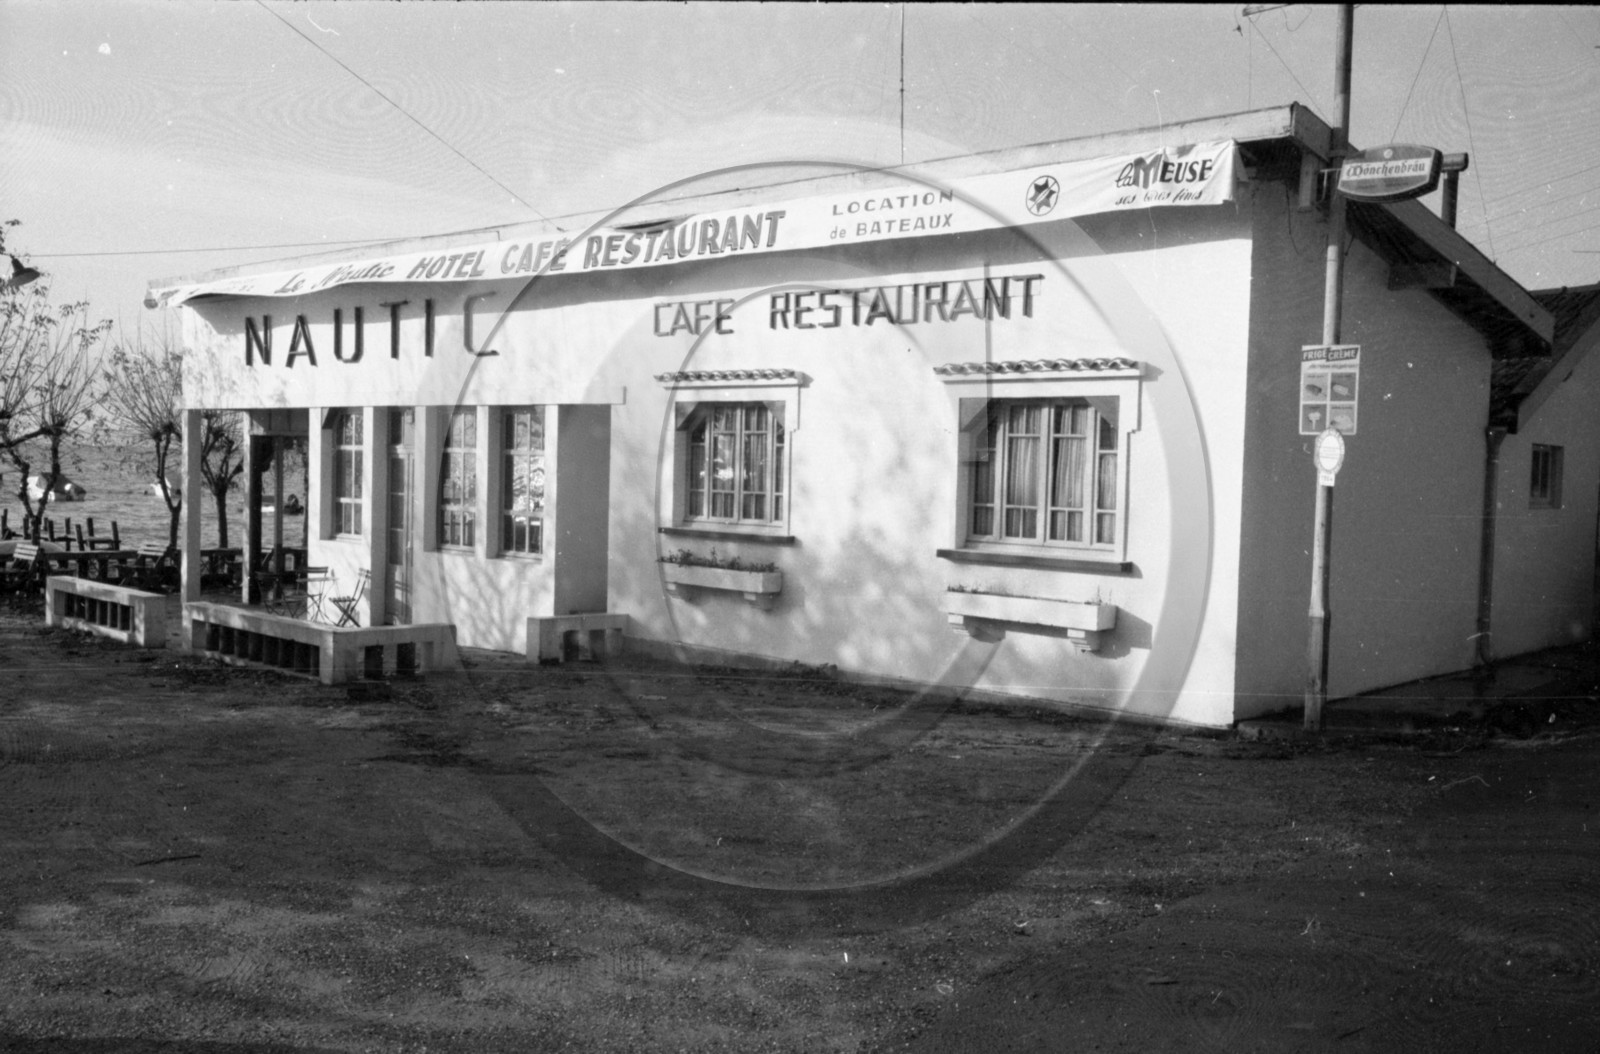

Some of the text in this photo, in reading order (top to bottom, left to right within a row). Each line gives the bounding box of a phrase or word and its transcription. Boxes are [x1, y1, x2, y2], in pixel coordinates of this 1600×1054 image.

[829, 213, 953, 240] de BATEAUX
[832, 189, 953, 216] LOCATION
[406, 249, 487, 280] HOTEL
[500, 236, 569, 275] CAFÉ
[583, 209, 787, 270] RESTAURANT
[244, 291, 500, 369] NAUTIC
[653, 273, 1046, 337] CAFE RESTAURANT
